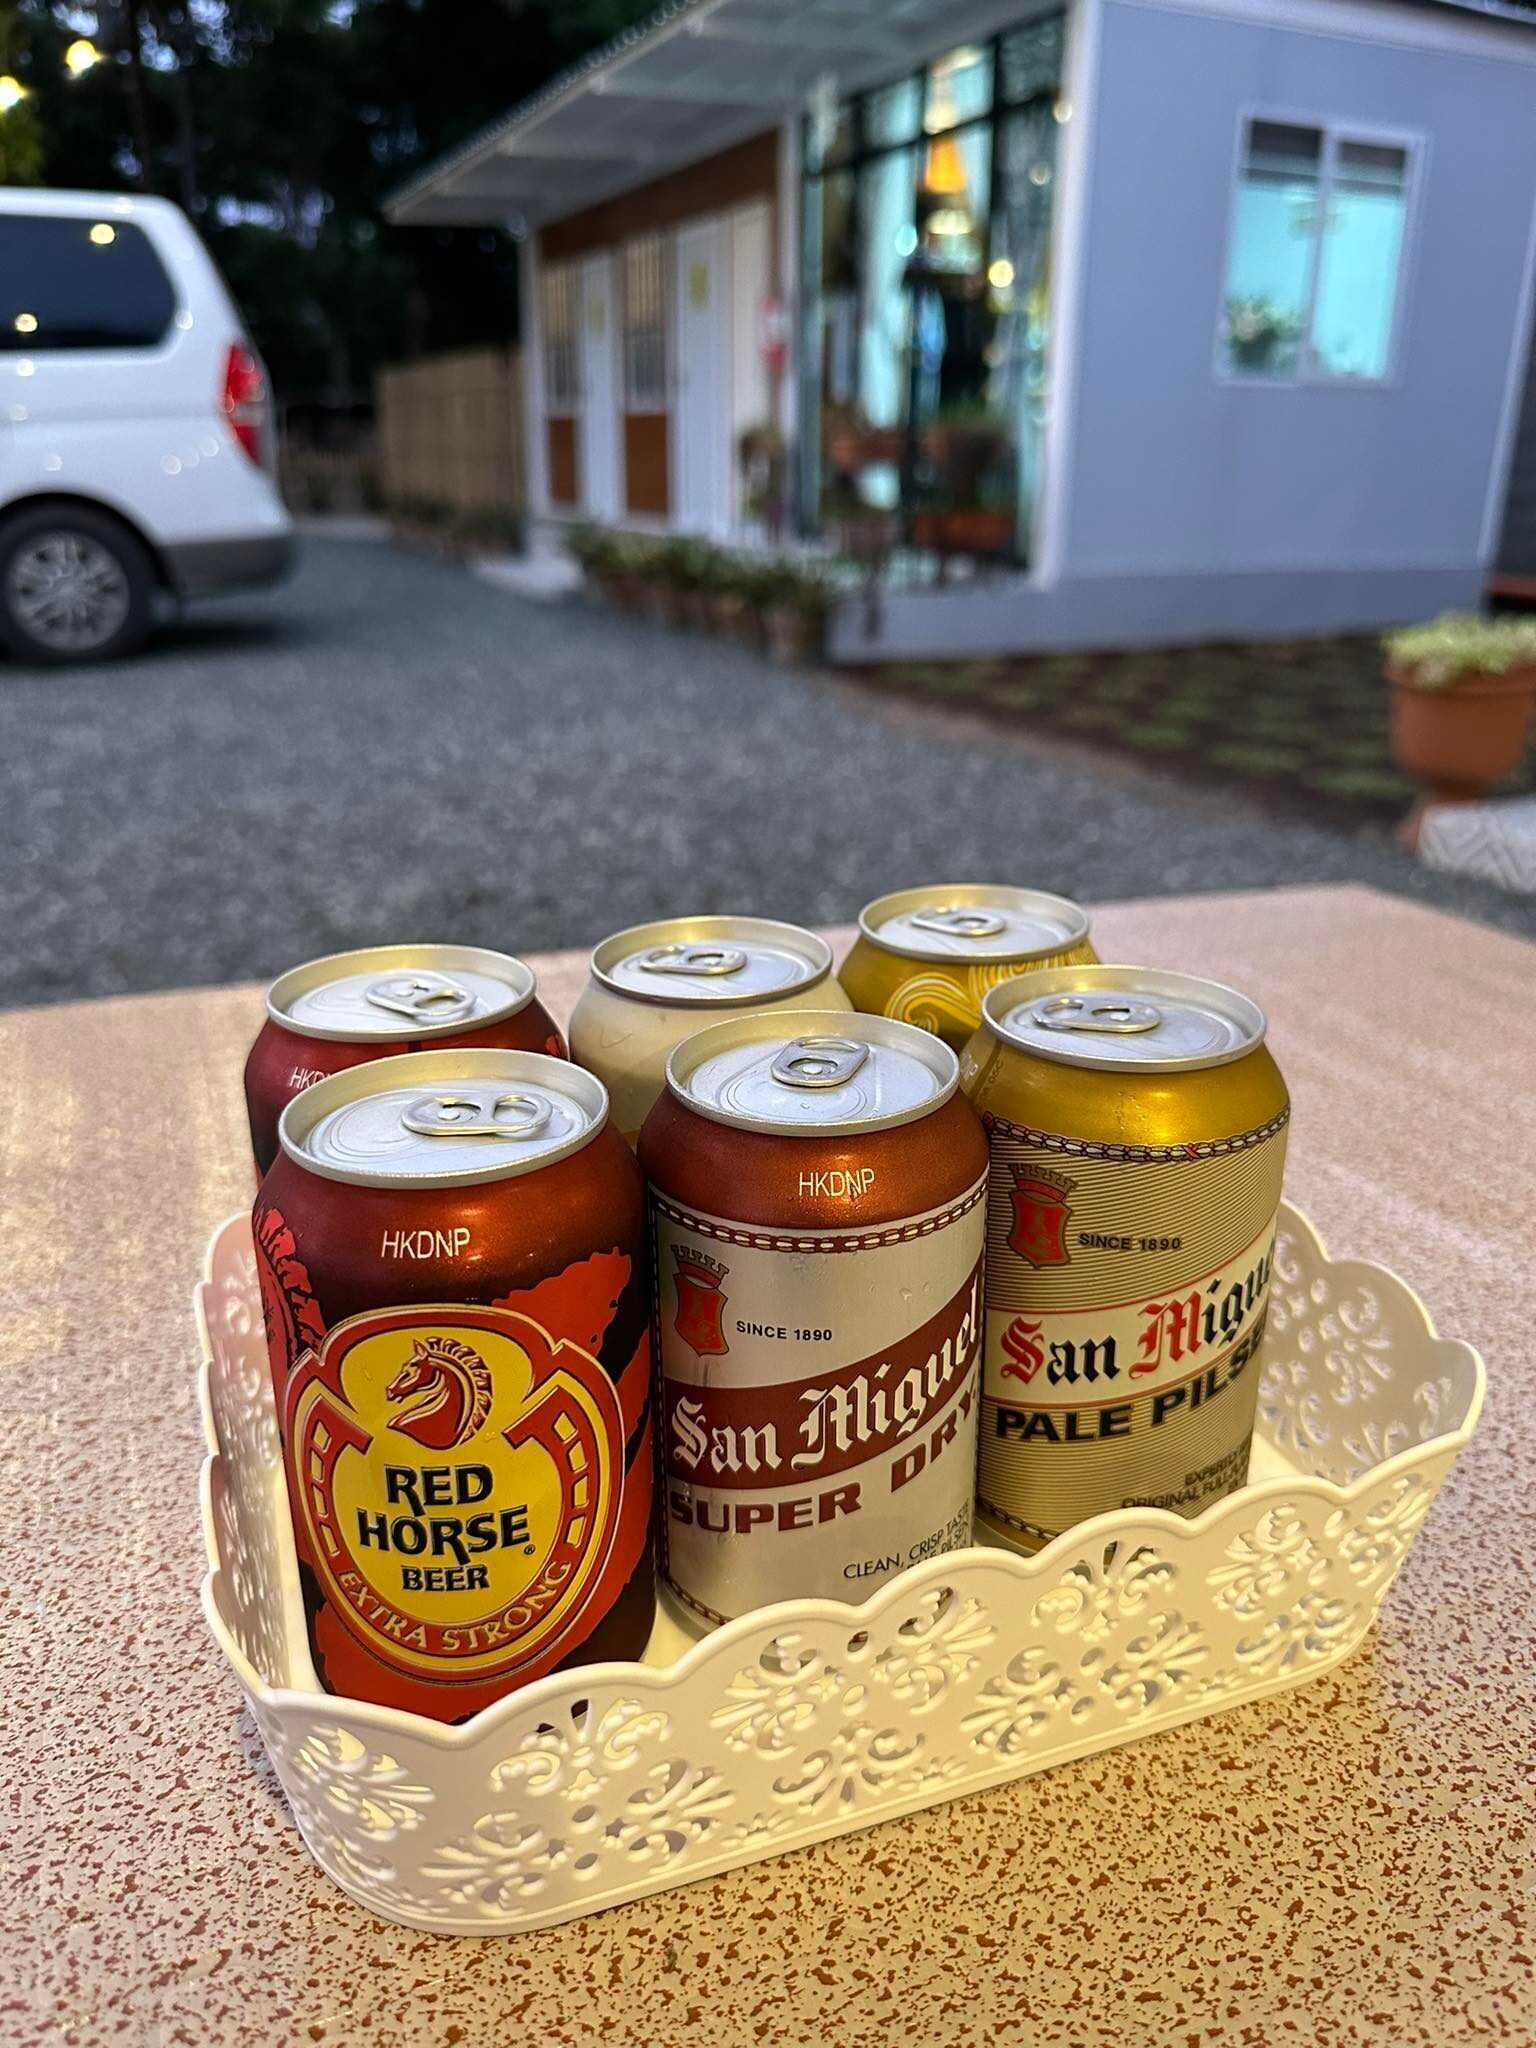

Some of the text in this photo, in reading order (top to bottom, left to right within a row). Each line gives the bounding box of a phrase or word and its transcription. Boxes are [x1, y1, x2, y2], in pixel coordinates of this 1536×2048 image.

[798, 1167, 875, 1198] HKDNP
[380, 1226, 471, 1260] HKDNP
[1078, 1232, 1182, 1250] SINCE 1890
[736, 1320, 833, 1342] SINCE 1890
[1000, 1316, 1120, 1385] San
[671, 1273, 978, 1474] San Miguel
[996, 1403, 1134, 1442] PALE
[383, 1462, 493, 1518] RED
[669, 1482, 863, 1534] SUPER
[355, 1504, 532, 1566] HORSE
[908, 1528, 944, 1561] CRISP
[402, 1563, 490, 1593] BEER
[339, 1560, 572, 1651] EXTRA STRONG
